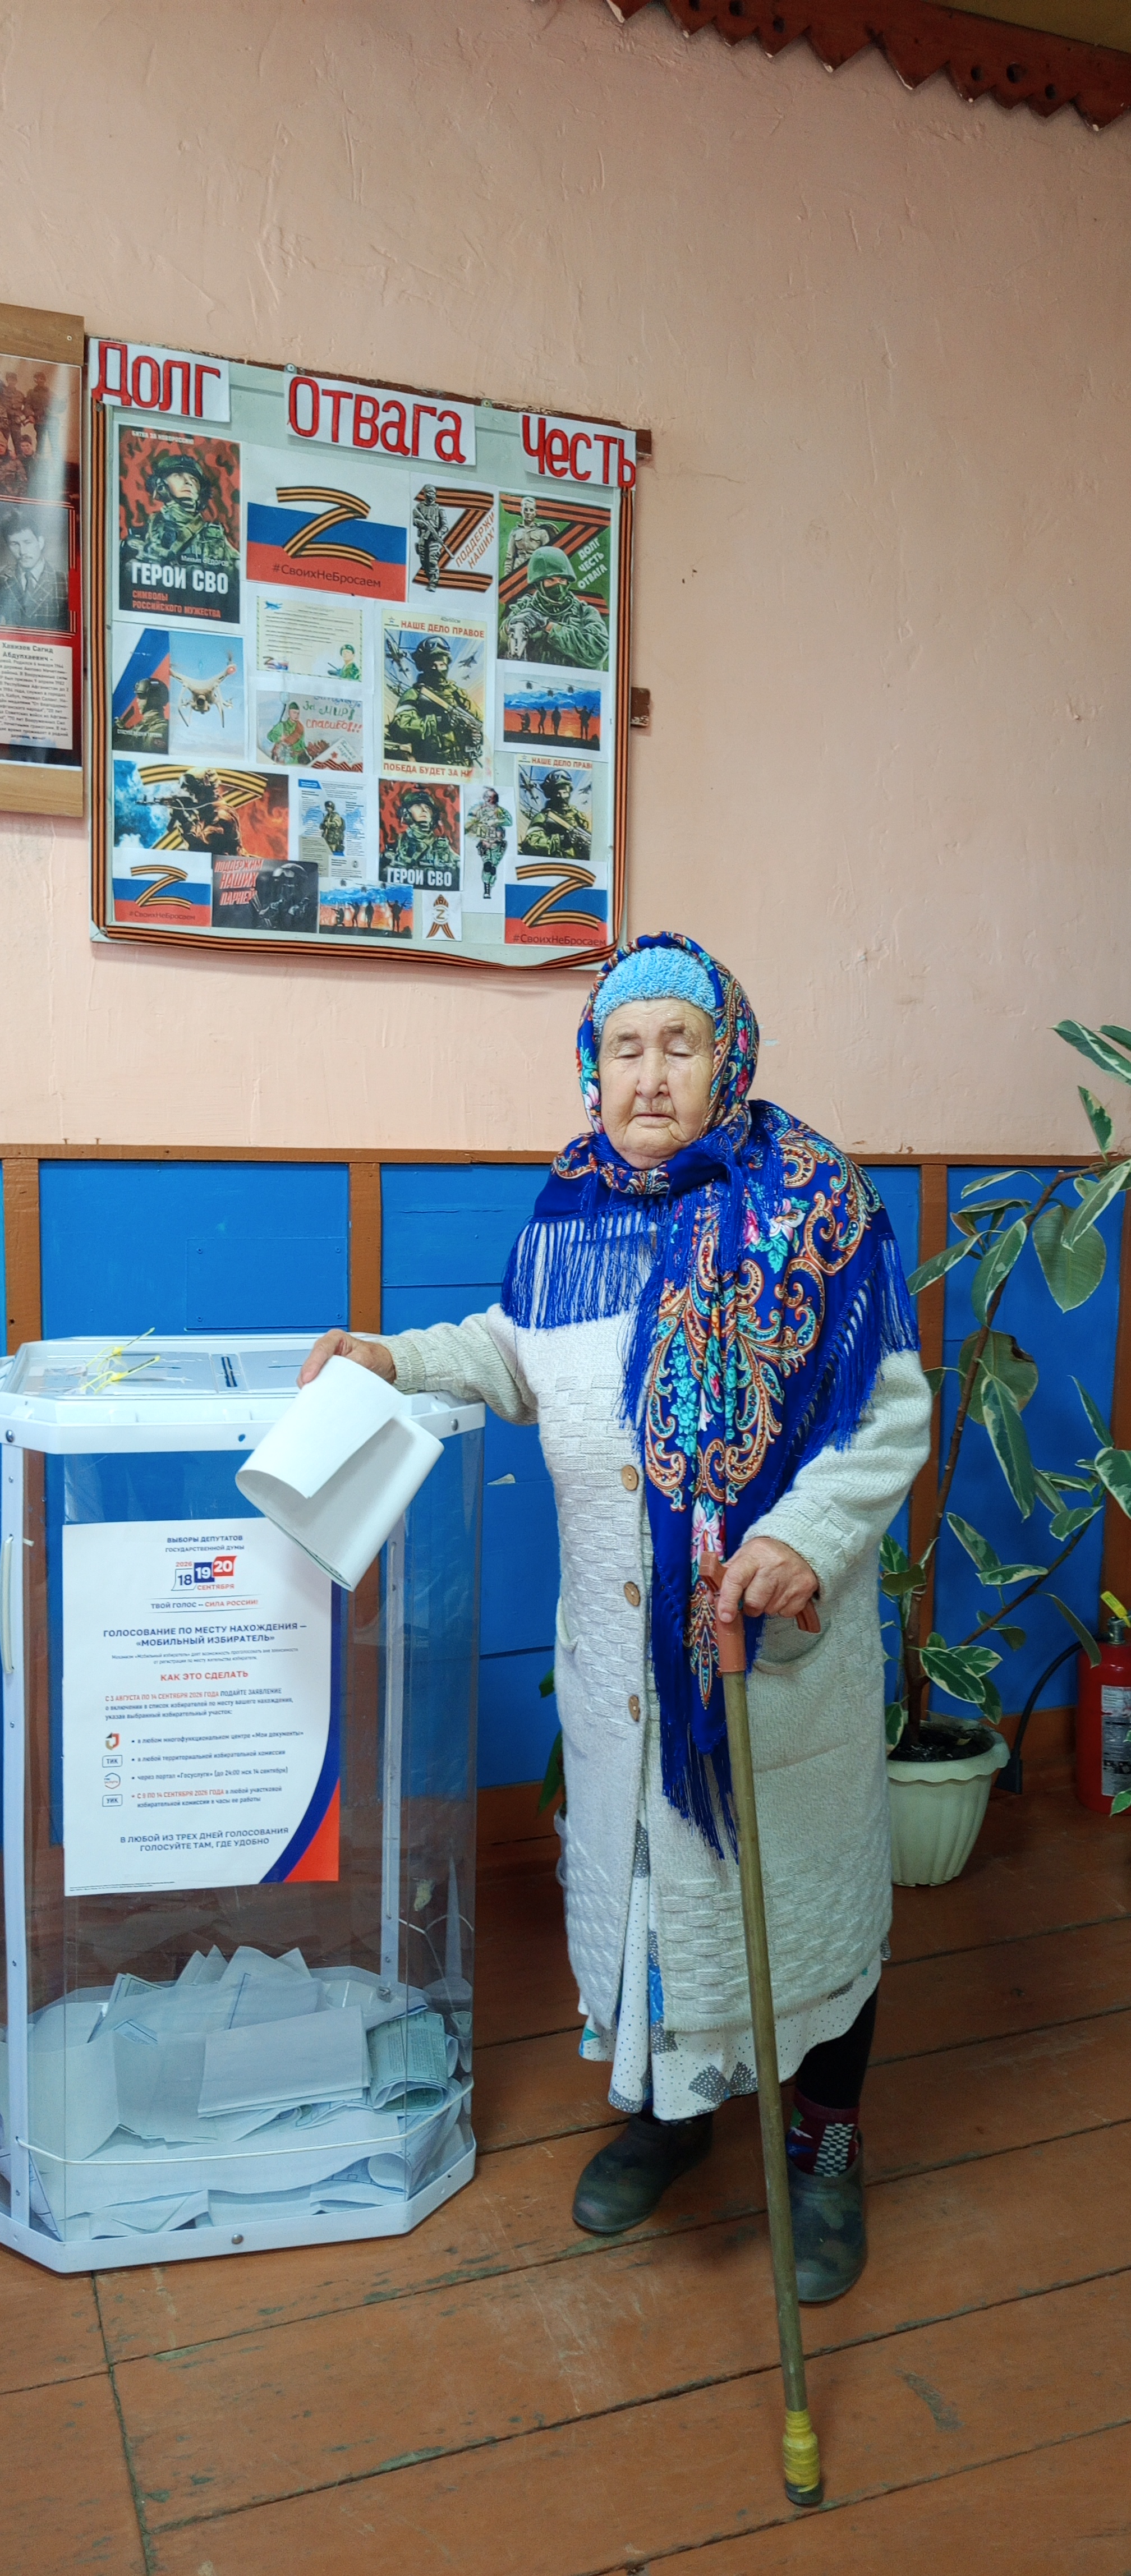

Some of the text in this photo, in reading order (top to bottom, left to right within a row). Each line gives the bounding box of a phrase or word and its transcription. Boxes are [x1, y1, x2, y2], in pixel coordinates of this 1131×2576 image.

[91, 341, 220, 417] Долг
[288, 376, 466, 464] Отвага
[522, 415, 636, 489] Честь
[578, 537, 600, 560] ДОЛГ
[578, 552, 604, 572] ЧЕСТЬ
[132, 562, 228, 595] ГЕРОИ СВО
[272, 564, 381, 588] #СвоихНеБросаем
[577, 564, 608, 590] ОТВАГА
[132, 590, 168, 601] СИМВОЛЫ
[132, 600, 221, 618] РОССИЙСКОГО МУЖЕСТВА
[401, 620, 425, 630] НАШЕ
[427, 624, 450, 633] ДЕЛО
[452, 627, 485, 638] ПРАВОЕ
[33, 645, 54, 654] Сагид
[383, 763, 417, 774] ПОБЕДА
[420, 767, 445, 776] БУДЕТ
[214, 859, 264, 872] ПОДДЕРЖИМ
[219, 872, 259, 889] НАШИХ
[387, 867, 452, 886] ГЕРОИ СВО
[513, 934, 606, 946] #СвоихНеБросаем
[195, 1567, 211, 1579] 19
[214, 1560, 233, 1572] 20
[178, 1574, 192, 1586] 18
[103, 1627, 176, 1637] ГОЛОСОВАНИЕ
[229, 1623, 297, 1632] НАХОЖДЕНИЯ
[136, 1635, 275, 1646] «МОБИЛЬНЫЙ ИЗБИРАТЕЛЬ»
[205, 1671, 249, 1680] СДЕЛАТЬ
[171, 1701, 207, 1710] избирателей
[162, 1710, 207, 1718] избирательный
[128, 1834, 160, 1843] ЛЮБОЙ
[200, 1830, 223, 1840] ДНЕЙ
[225, 1828, 288, 1838] ГОЛОСОВАНИЯ
[140, 1842, 191, 1852] ГОЛОСУЙТЕ
[234, 1838, 269, 1846] УДОБНО
